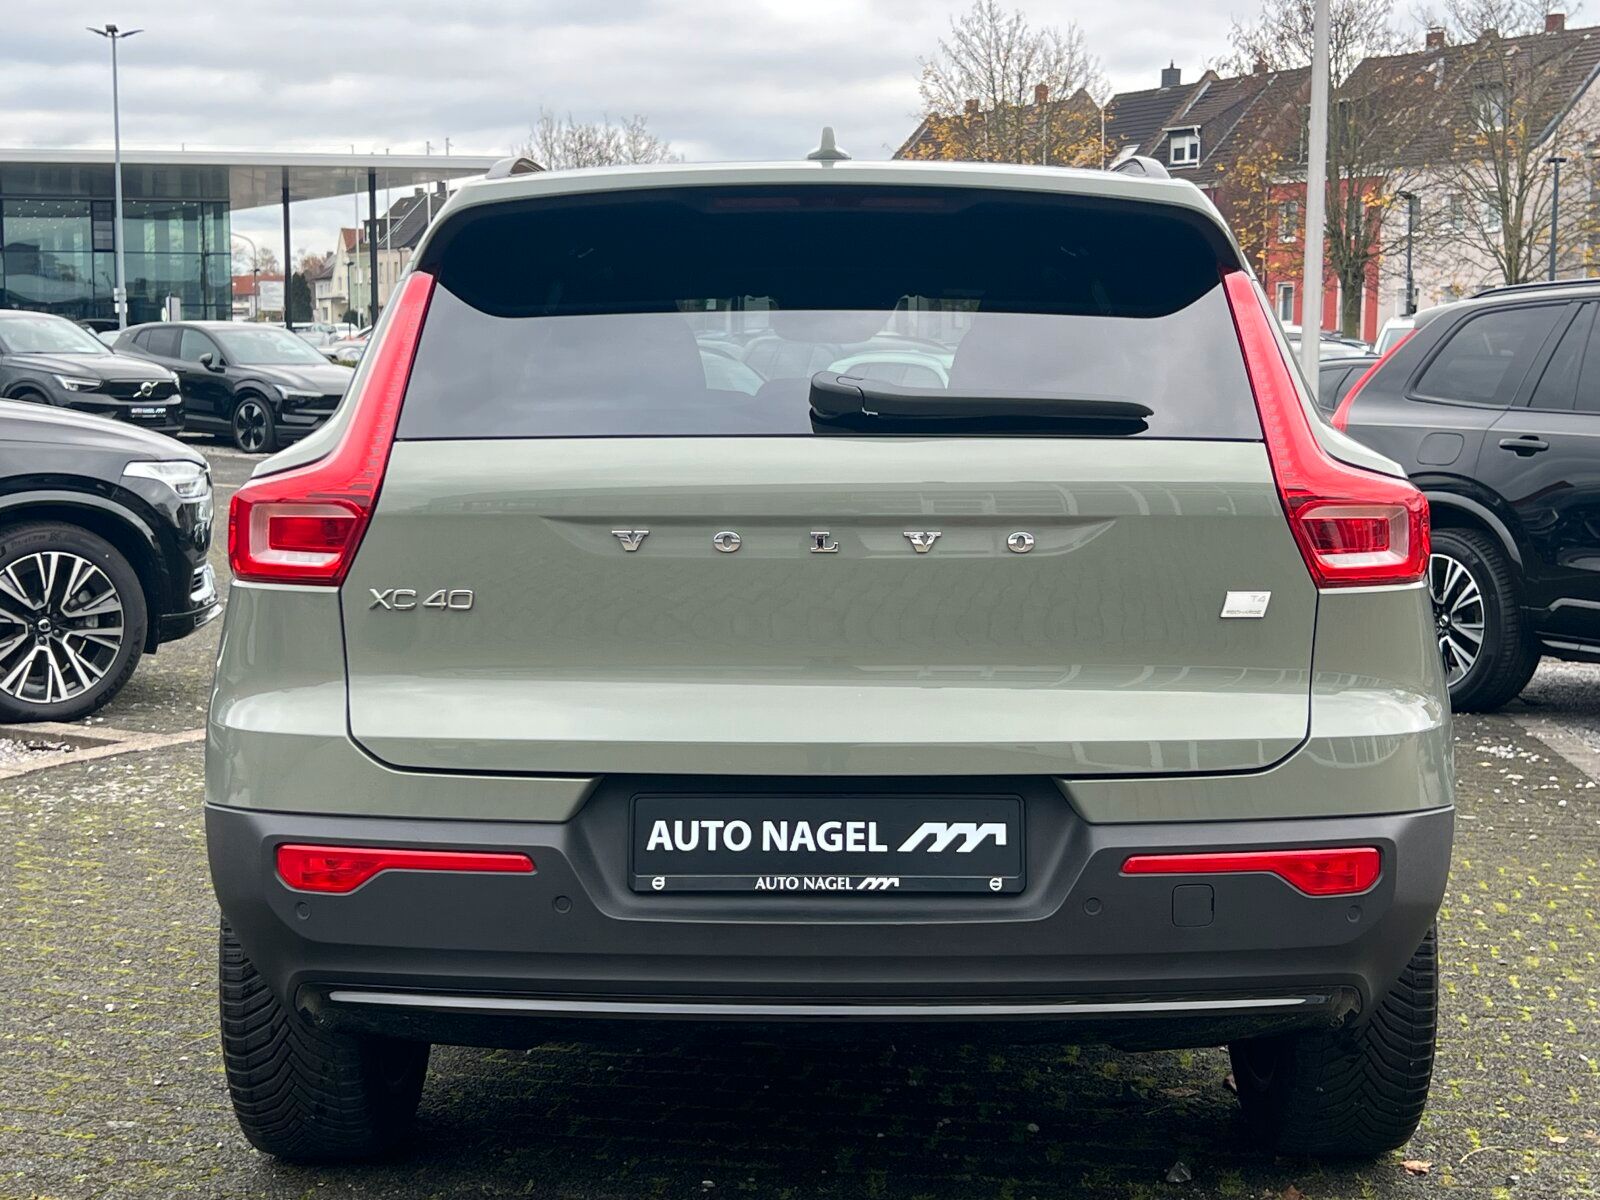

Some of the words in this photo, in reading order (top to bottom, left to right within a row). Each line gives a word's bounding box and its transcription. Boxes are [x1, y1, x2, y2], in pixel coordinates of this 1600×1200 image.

[611, 530, 1036, 554] VOLVO
[646, 819, 752, 853] AUTO
[762, 820, 888, 853] NAGEL
[754, 876, 801, 891] AUTO
[803, 876, 855, 891] NAGEL
